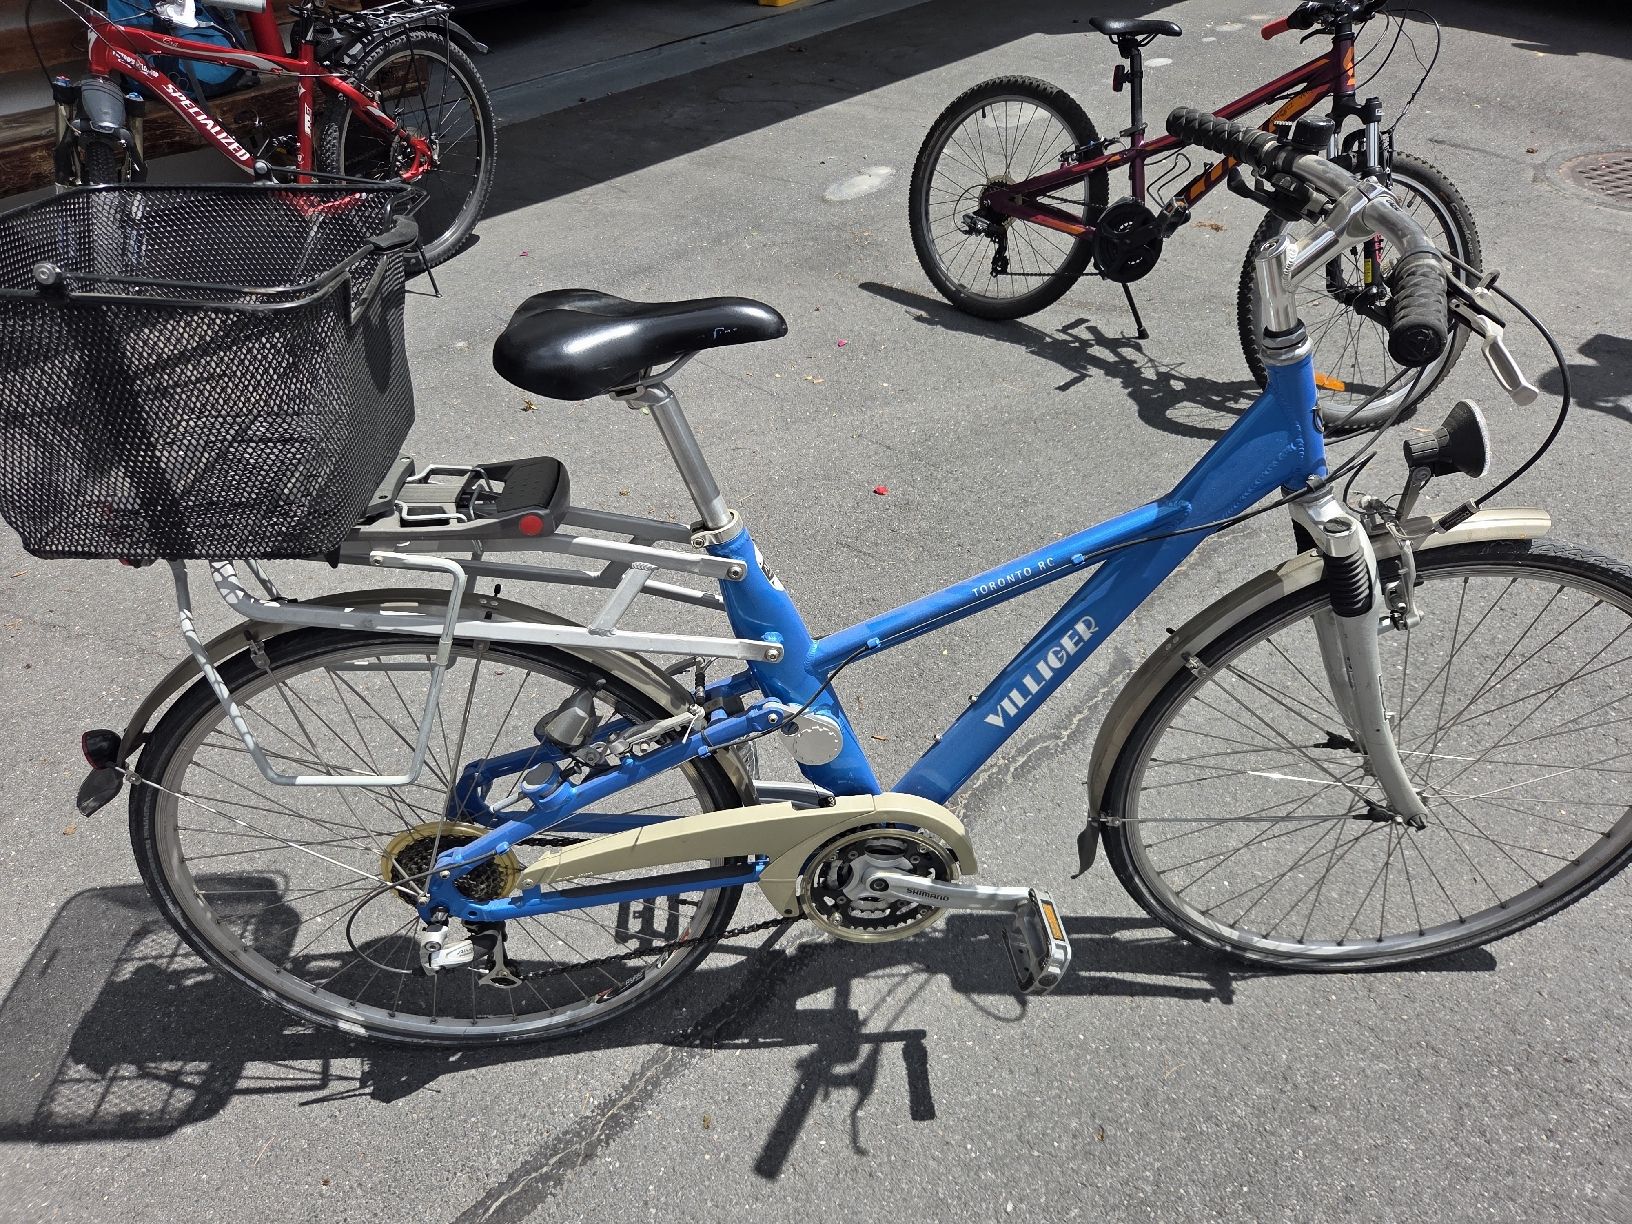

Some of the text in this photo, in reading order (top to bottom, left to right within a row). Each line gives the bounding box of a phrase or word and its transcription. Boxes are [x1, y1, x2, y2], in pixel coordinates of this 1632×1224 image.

[162, 83, 251, 161] SPECIALIZED
[972, 557, 1055, 597] TORONTO RC
[984, 615, 1099, 728] VILLIGER
[906, 887, 950, 901] SHIMANO
